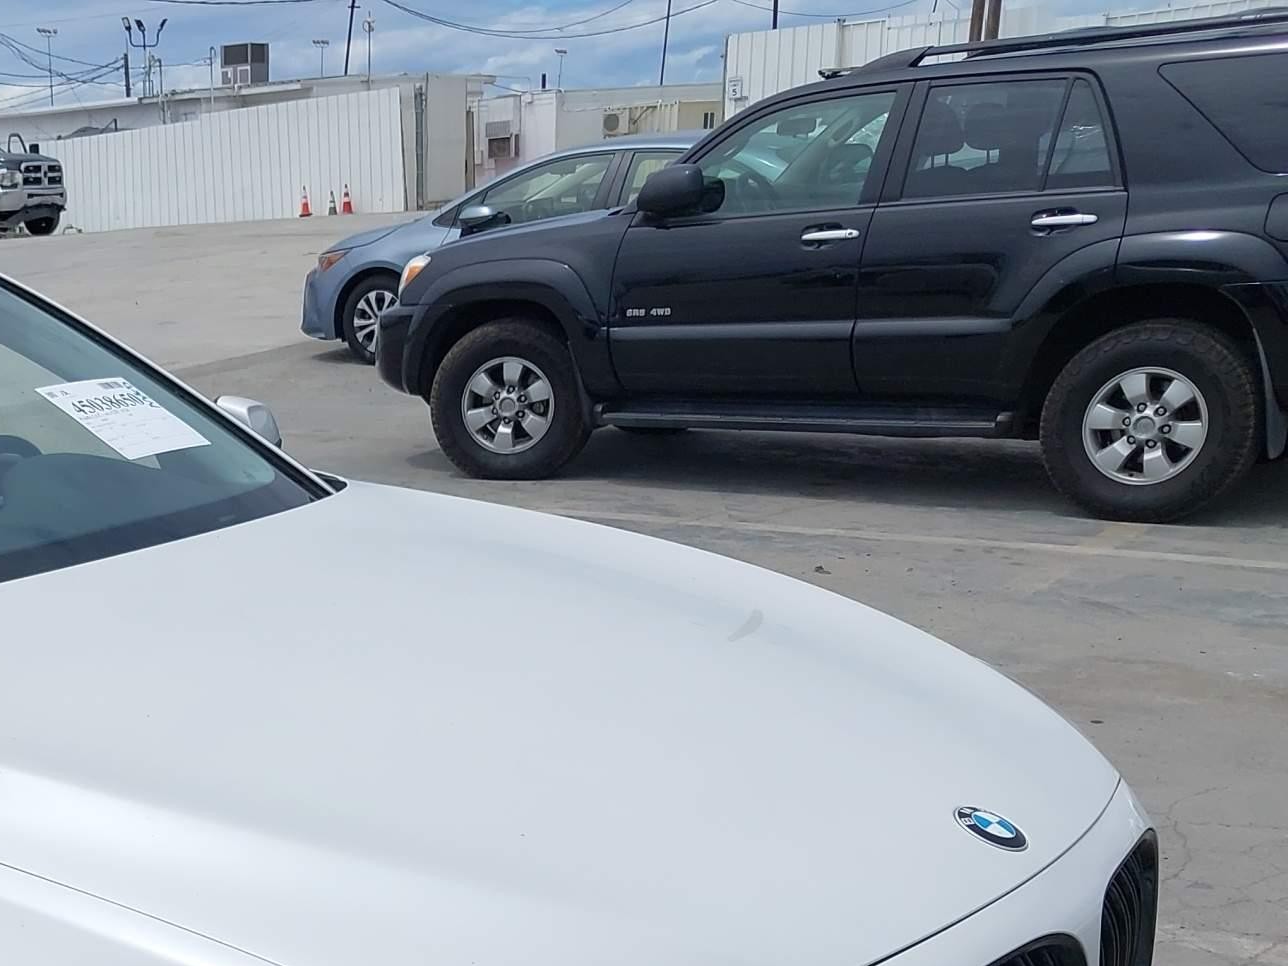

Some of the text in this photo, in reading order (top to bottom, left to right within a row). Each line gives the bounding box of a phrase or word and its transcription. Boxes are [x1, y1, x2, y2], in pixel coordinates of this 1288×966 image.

[732, 88, 738, 97] 5
[650, 307, 671, 316] 4WD
[71, 391, 145, 415] 45038650
